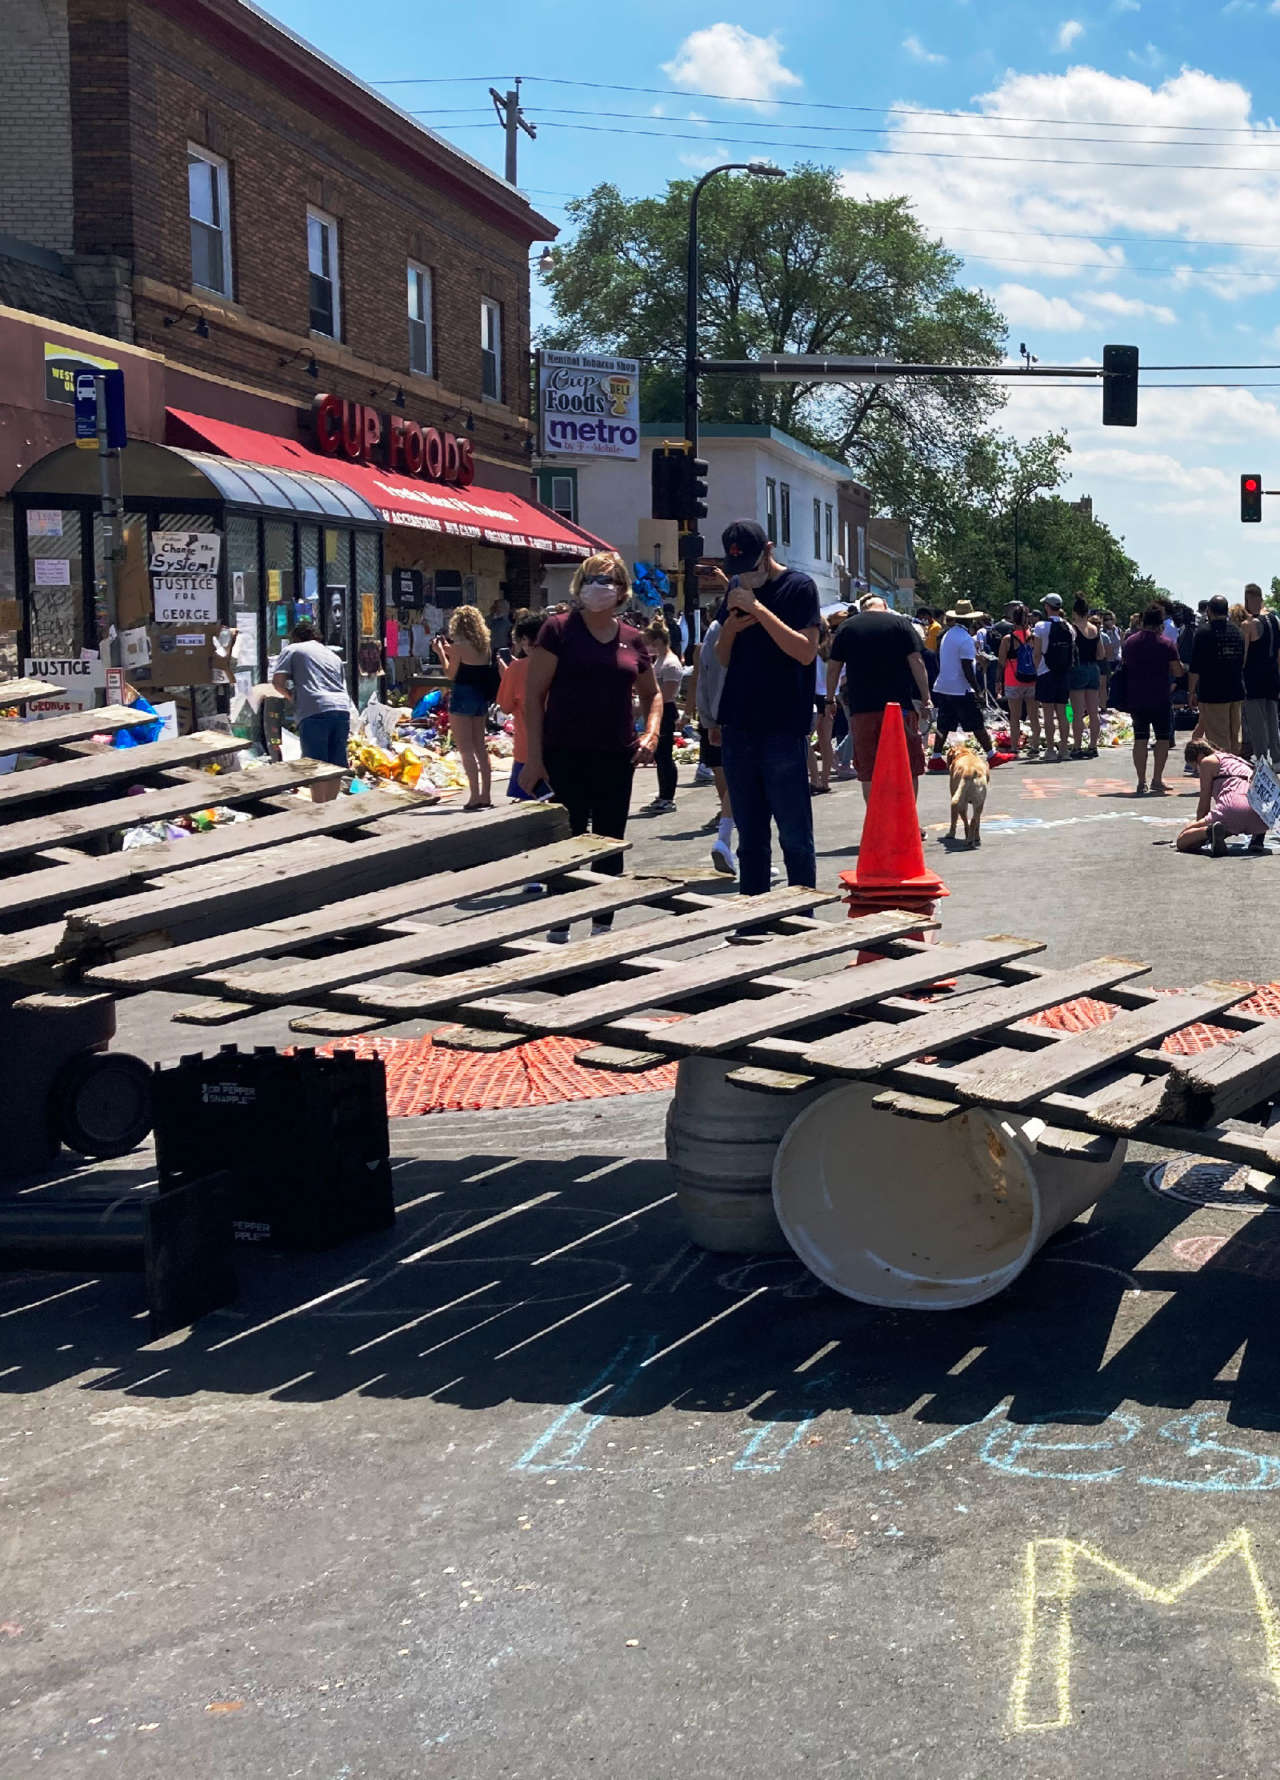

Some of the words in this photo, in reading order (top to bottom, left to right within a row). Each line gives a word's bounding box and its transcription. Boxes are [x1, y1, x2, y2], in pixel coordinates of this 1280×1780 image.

[616, 360, 637, 372] Shop
[51, 367, 75, 382] WEST
[551, 368, 600, 397] Cup
[545, 388, 605, 413] Foods
[548, 419, 637, 446] metro
[313, 393, 381, 459] CUP
[387, 414, 475, 487] FOODS
[161, 543, 196, 556] Change
[154, 578, 214, 590] JUSTICE
[174, 592, 196, 600] FOR
[162, 609, 211, 620] GEORGE
[29, 660, 92, 676] JUSTICE
[223, 1086, 257, 1096] PEPPER
[209, 1095, 249, 1105] SNAPPLE
[234, 1231, 259, 1241] PPLE
